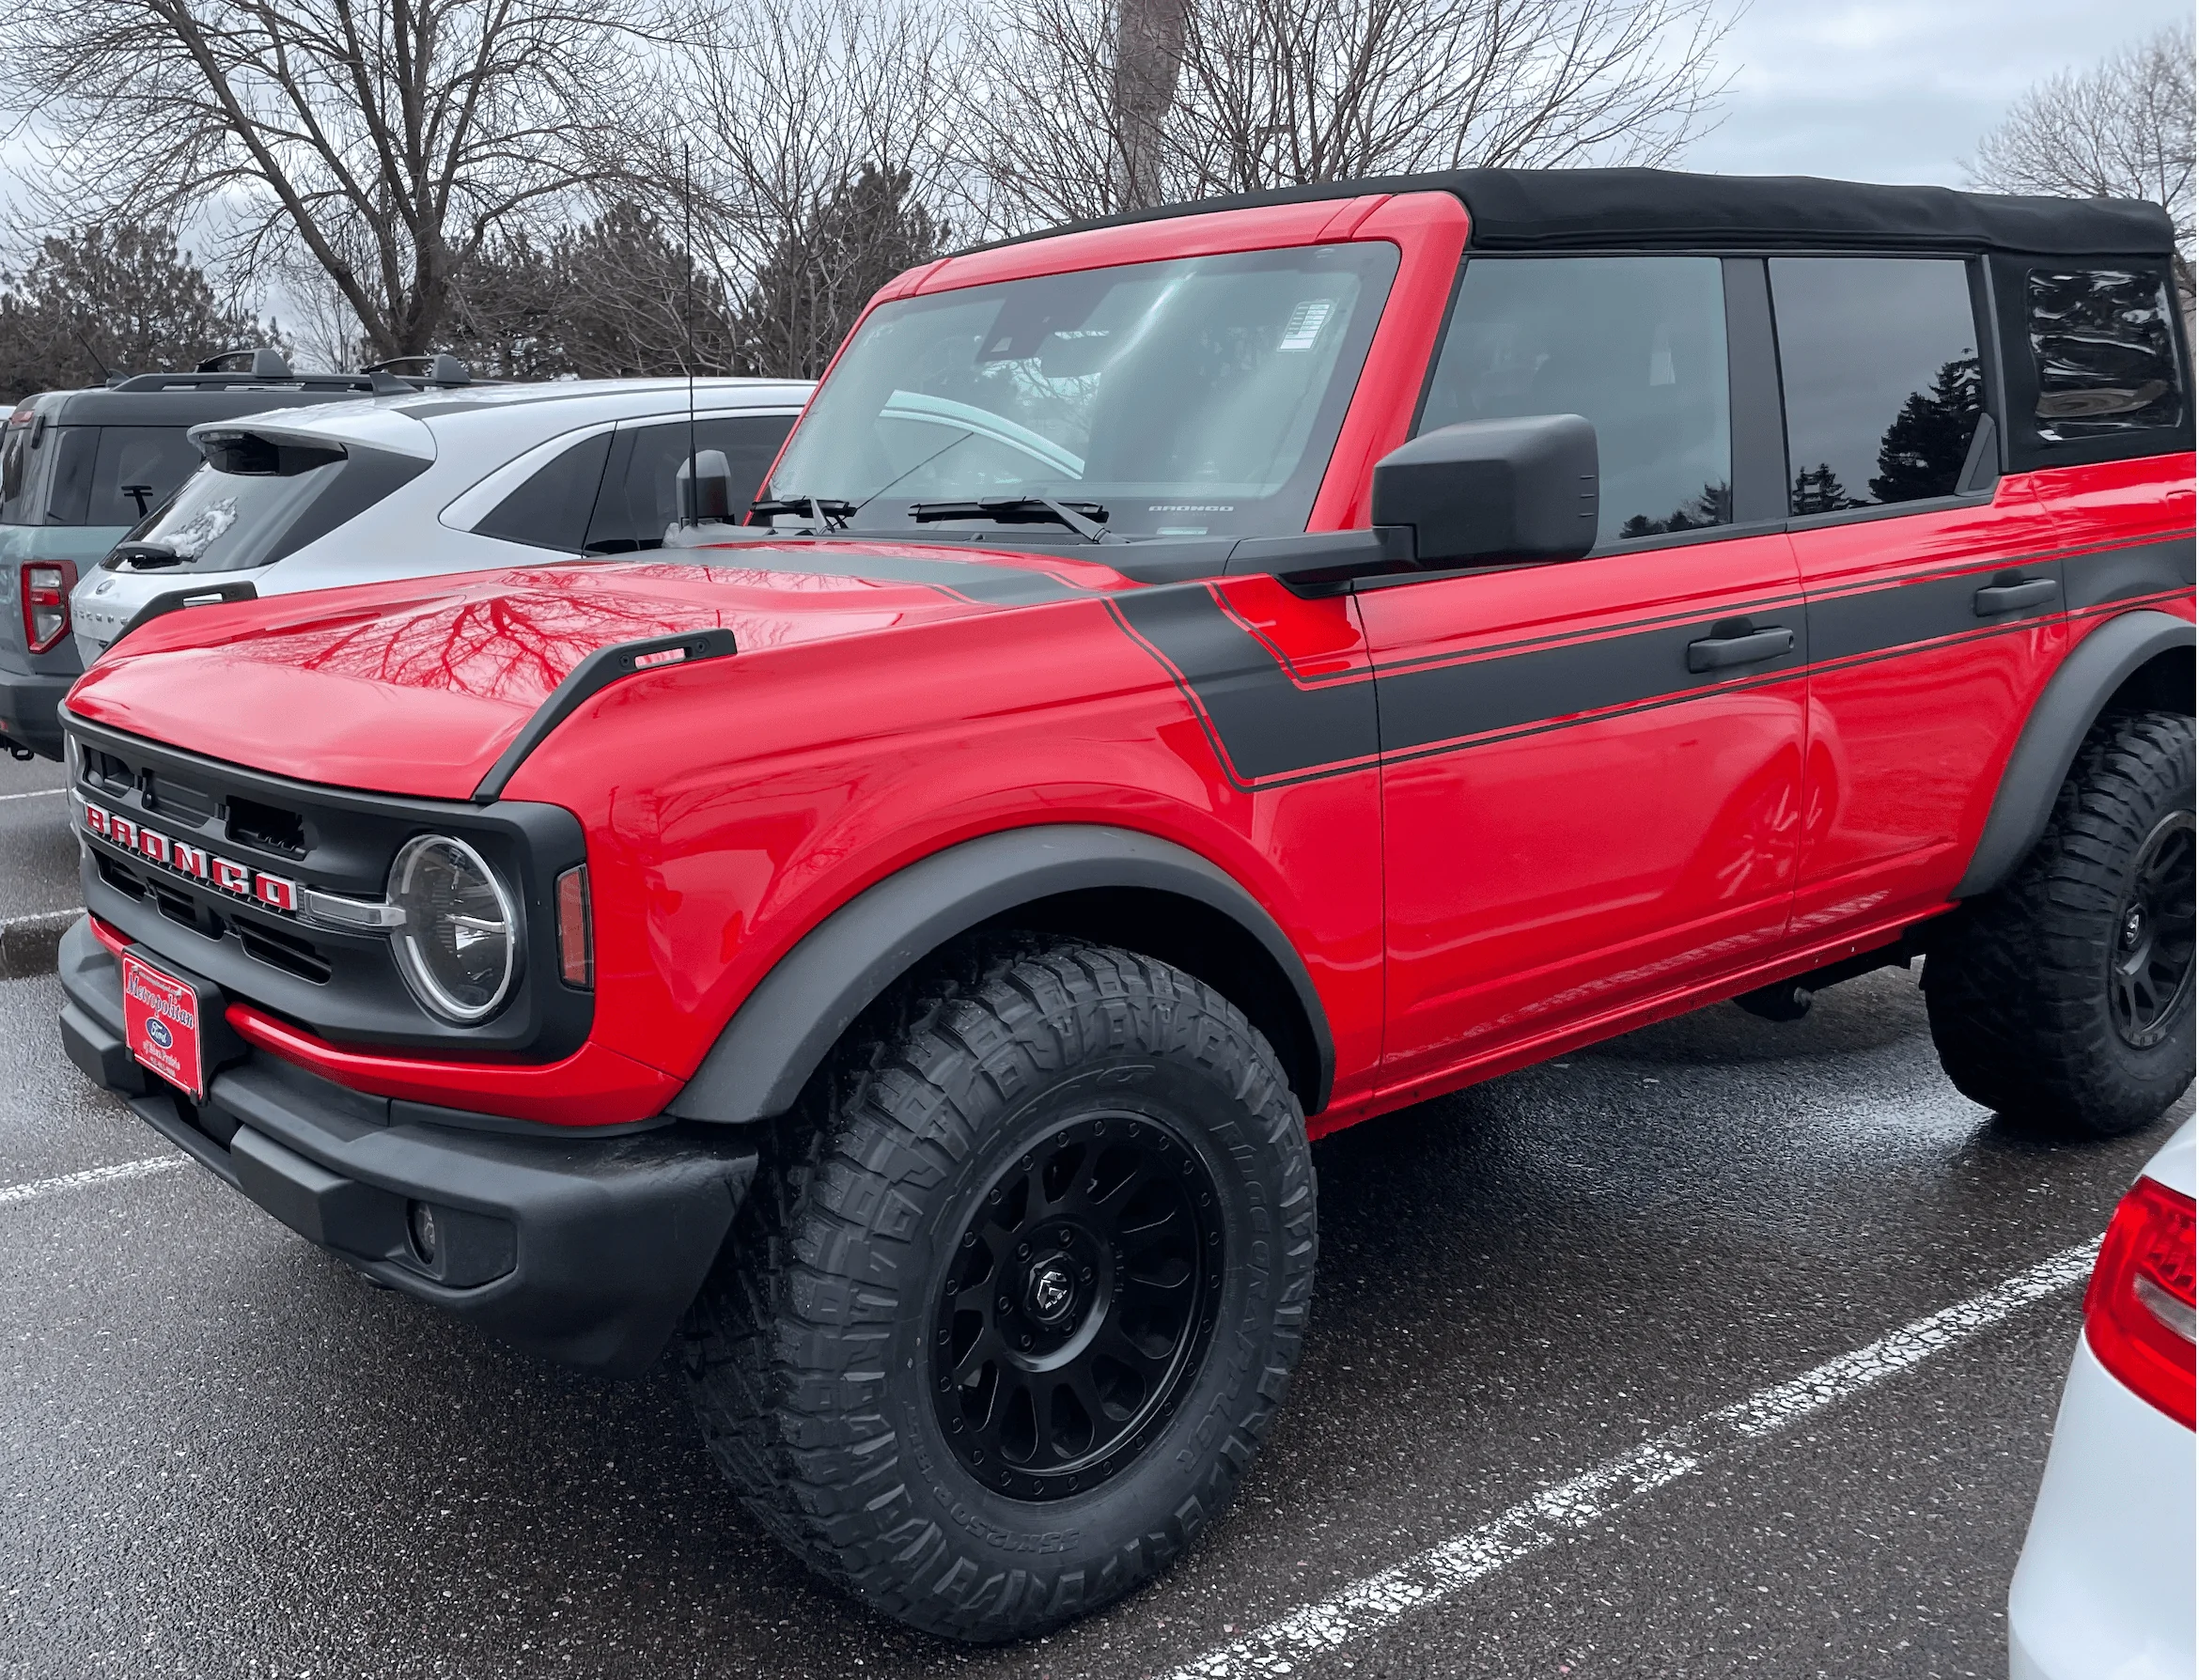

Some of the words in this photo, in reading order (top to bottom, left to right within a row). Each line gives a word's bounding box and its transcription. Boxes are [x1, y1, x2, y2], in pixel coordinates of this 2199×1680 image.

[86, 802, 298, 910] BRONCO
[127, 972, 194, 1030] Metropolitan
[151, 1020, 167, 1044] Ford
